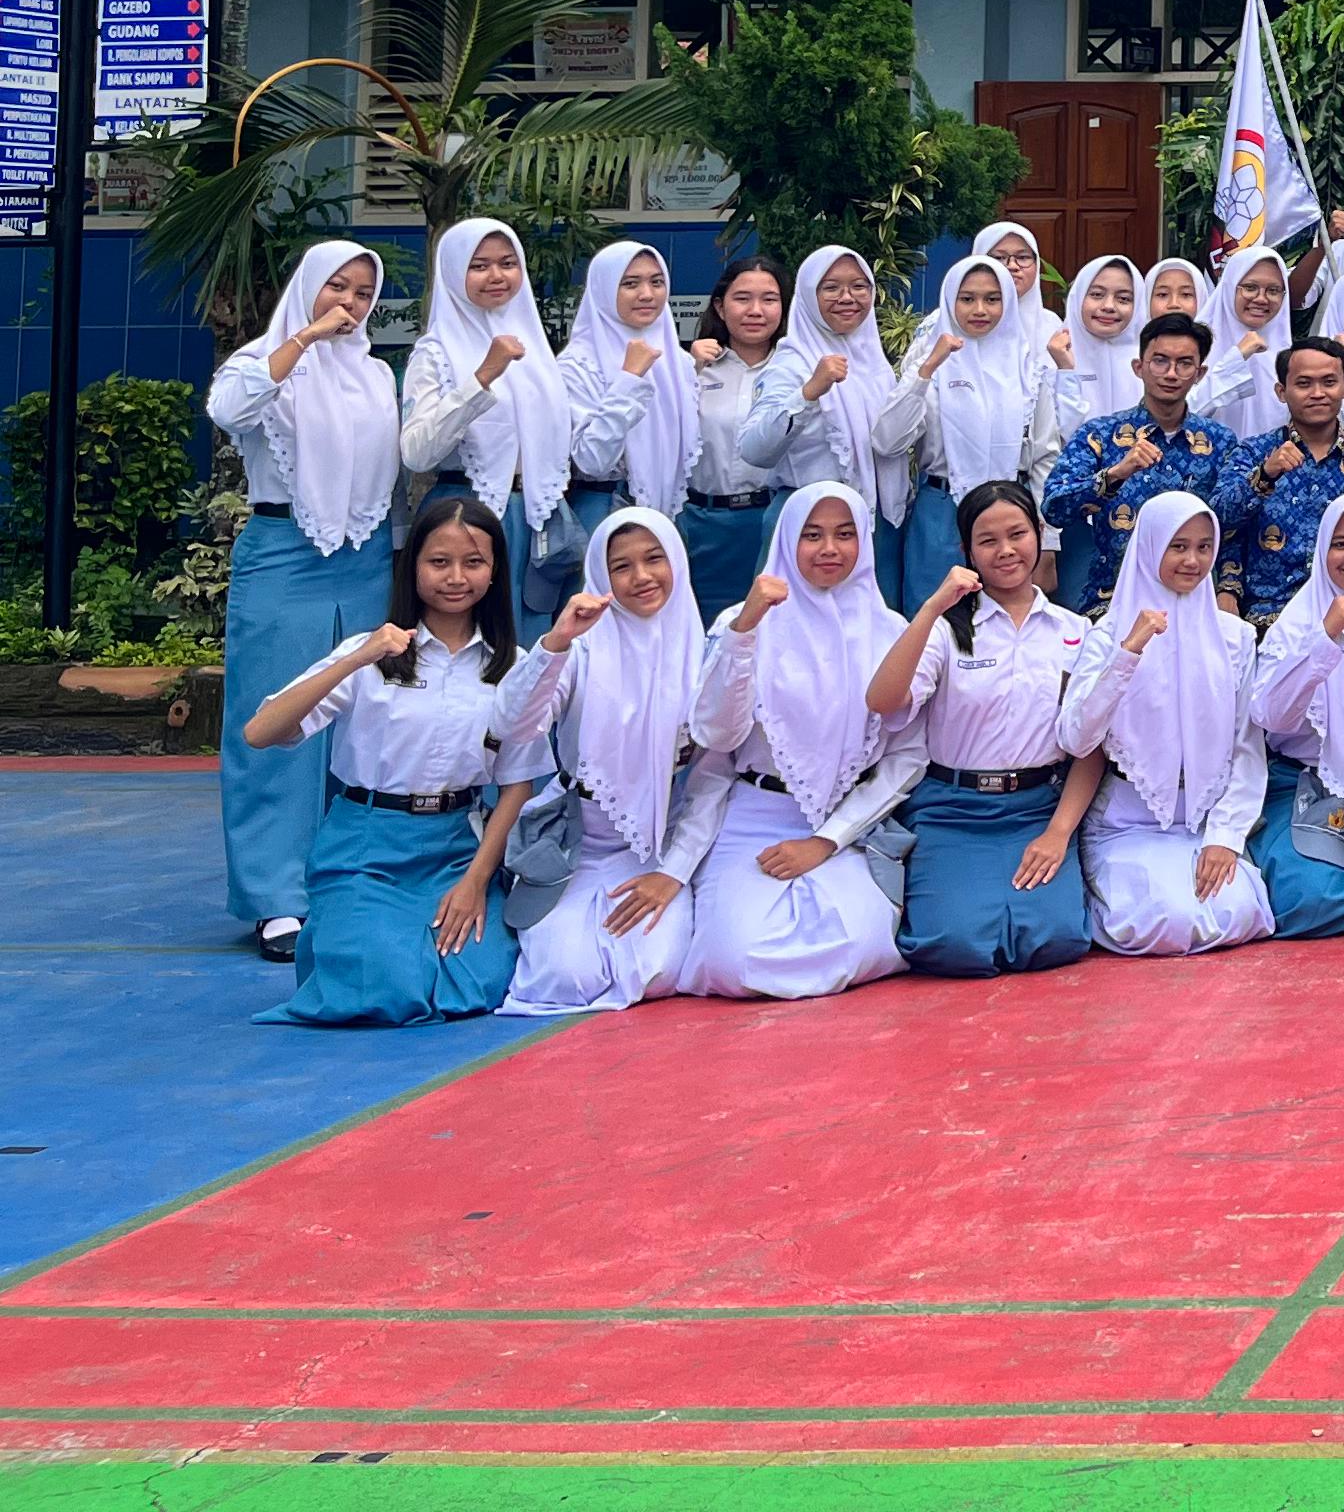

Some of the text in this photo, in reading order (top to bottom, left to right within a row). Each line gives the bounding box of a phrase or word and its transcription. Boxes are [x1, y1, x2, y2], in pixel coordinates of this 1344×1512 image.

[108, 0, 151, 15] GAZEBO
[107, 24, 160, 38] GUDANG
[0, 73, 33, 85] ANTAI
[107, 71, 173, 86] BANK SAMPAH
[115, 97, 169, 109] LANTAI
